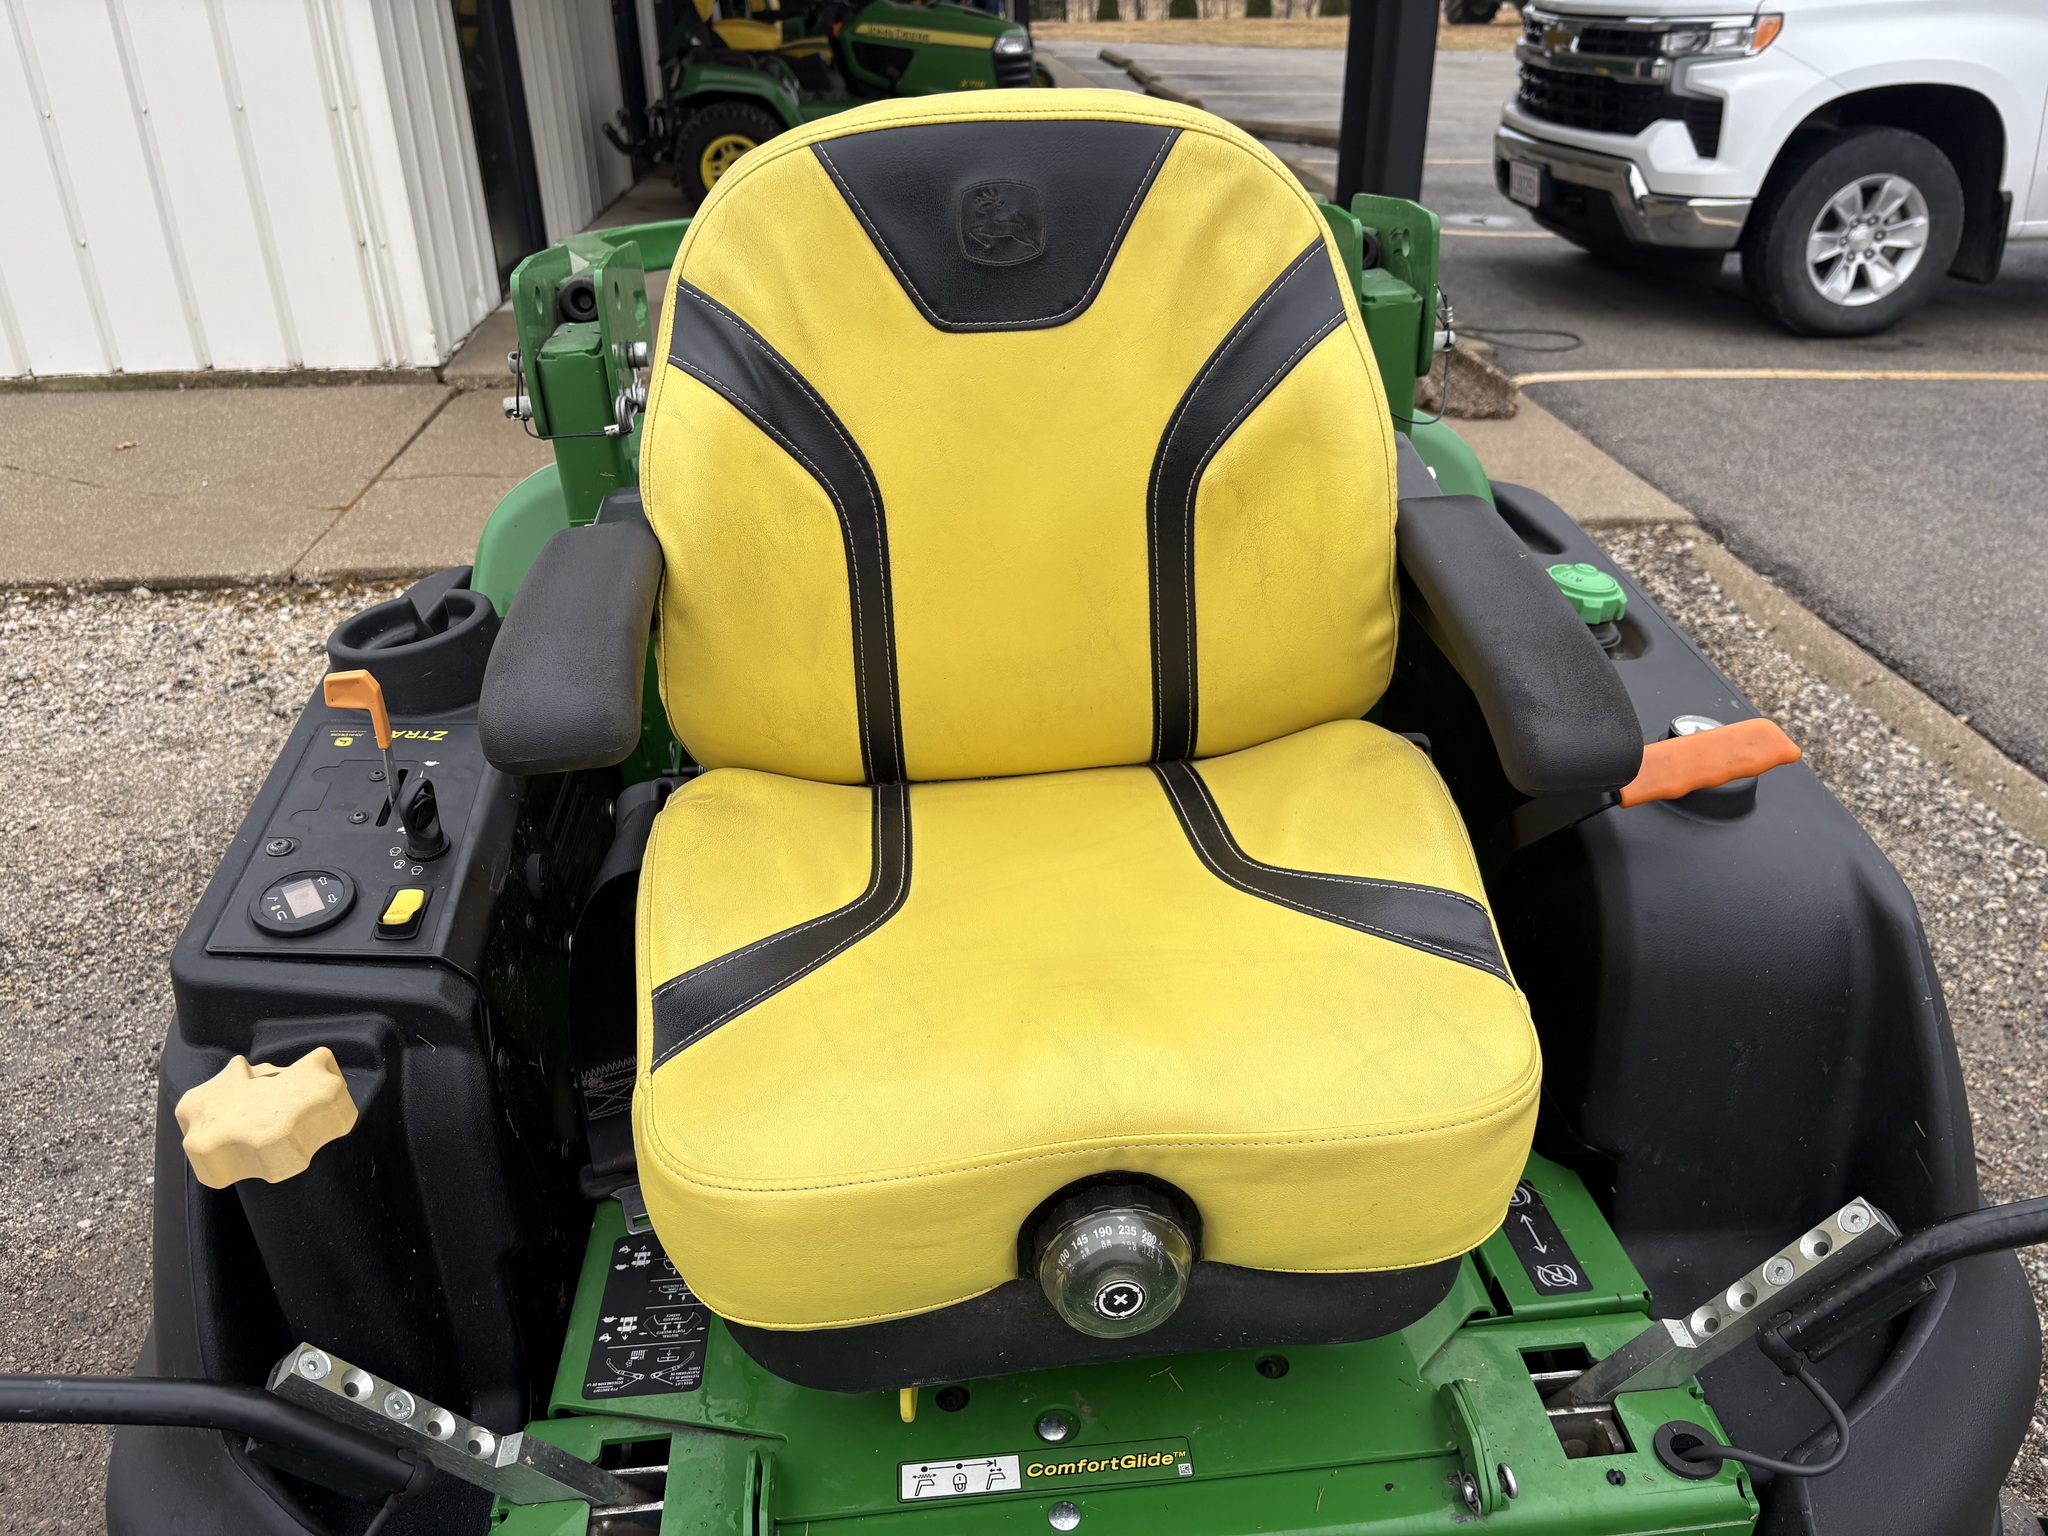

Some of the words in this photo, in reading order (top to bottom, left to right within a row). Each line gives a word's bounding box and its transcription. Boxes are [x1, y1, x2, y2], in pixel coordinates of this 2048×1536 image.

[374, 730, 449, 741] ZTRA
[1058, 1249, 1070, 1267] 100
[1071, 1234, 1088, 1250] 145
[1092, 1226, 1112, 1239] 190
[1118, 1225, 1137, 1236] 235
[1141, 1229, 1157, 1247] 280
